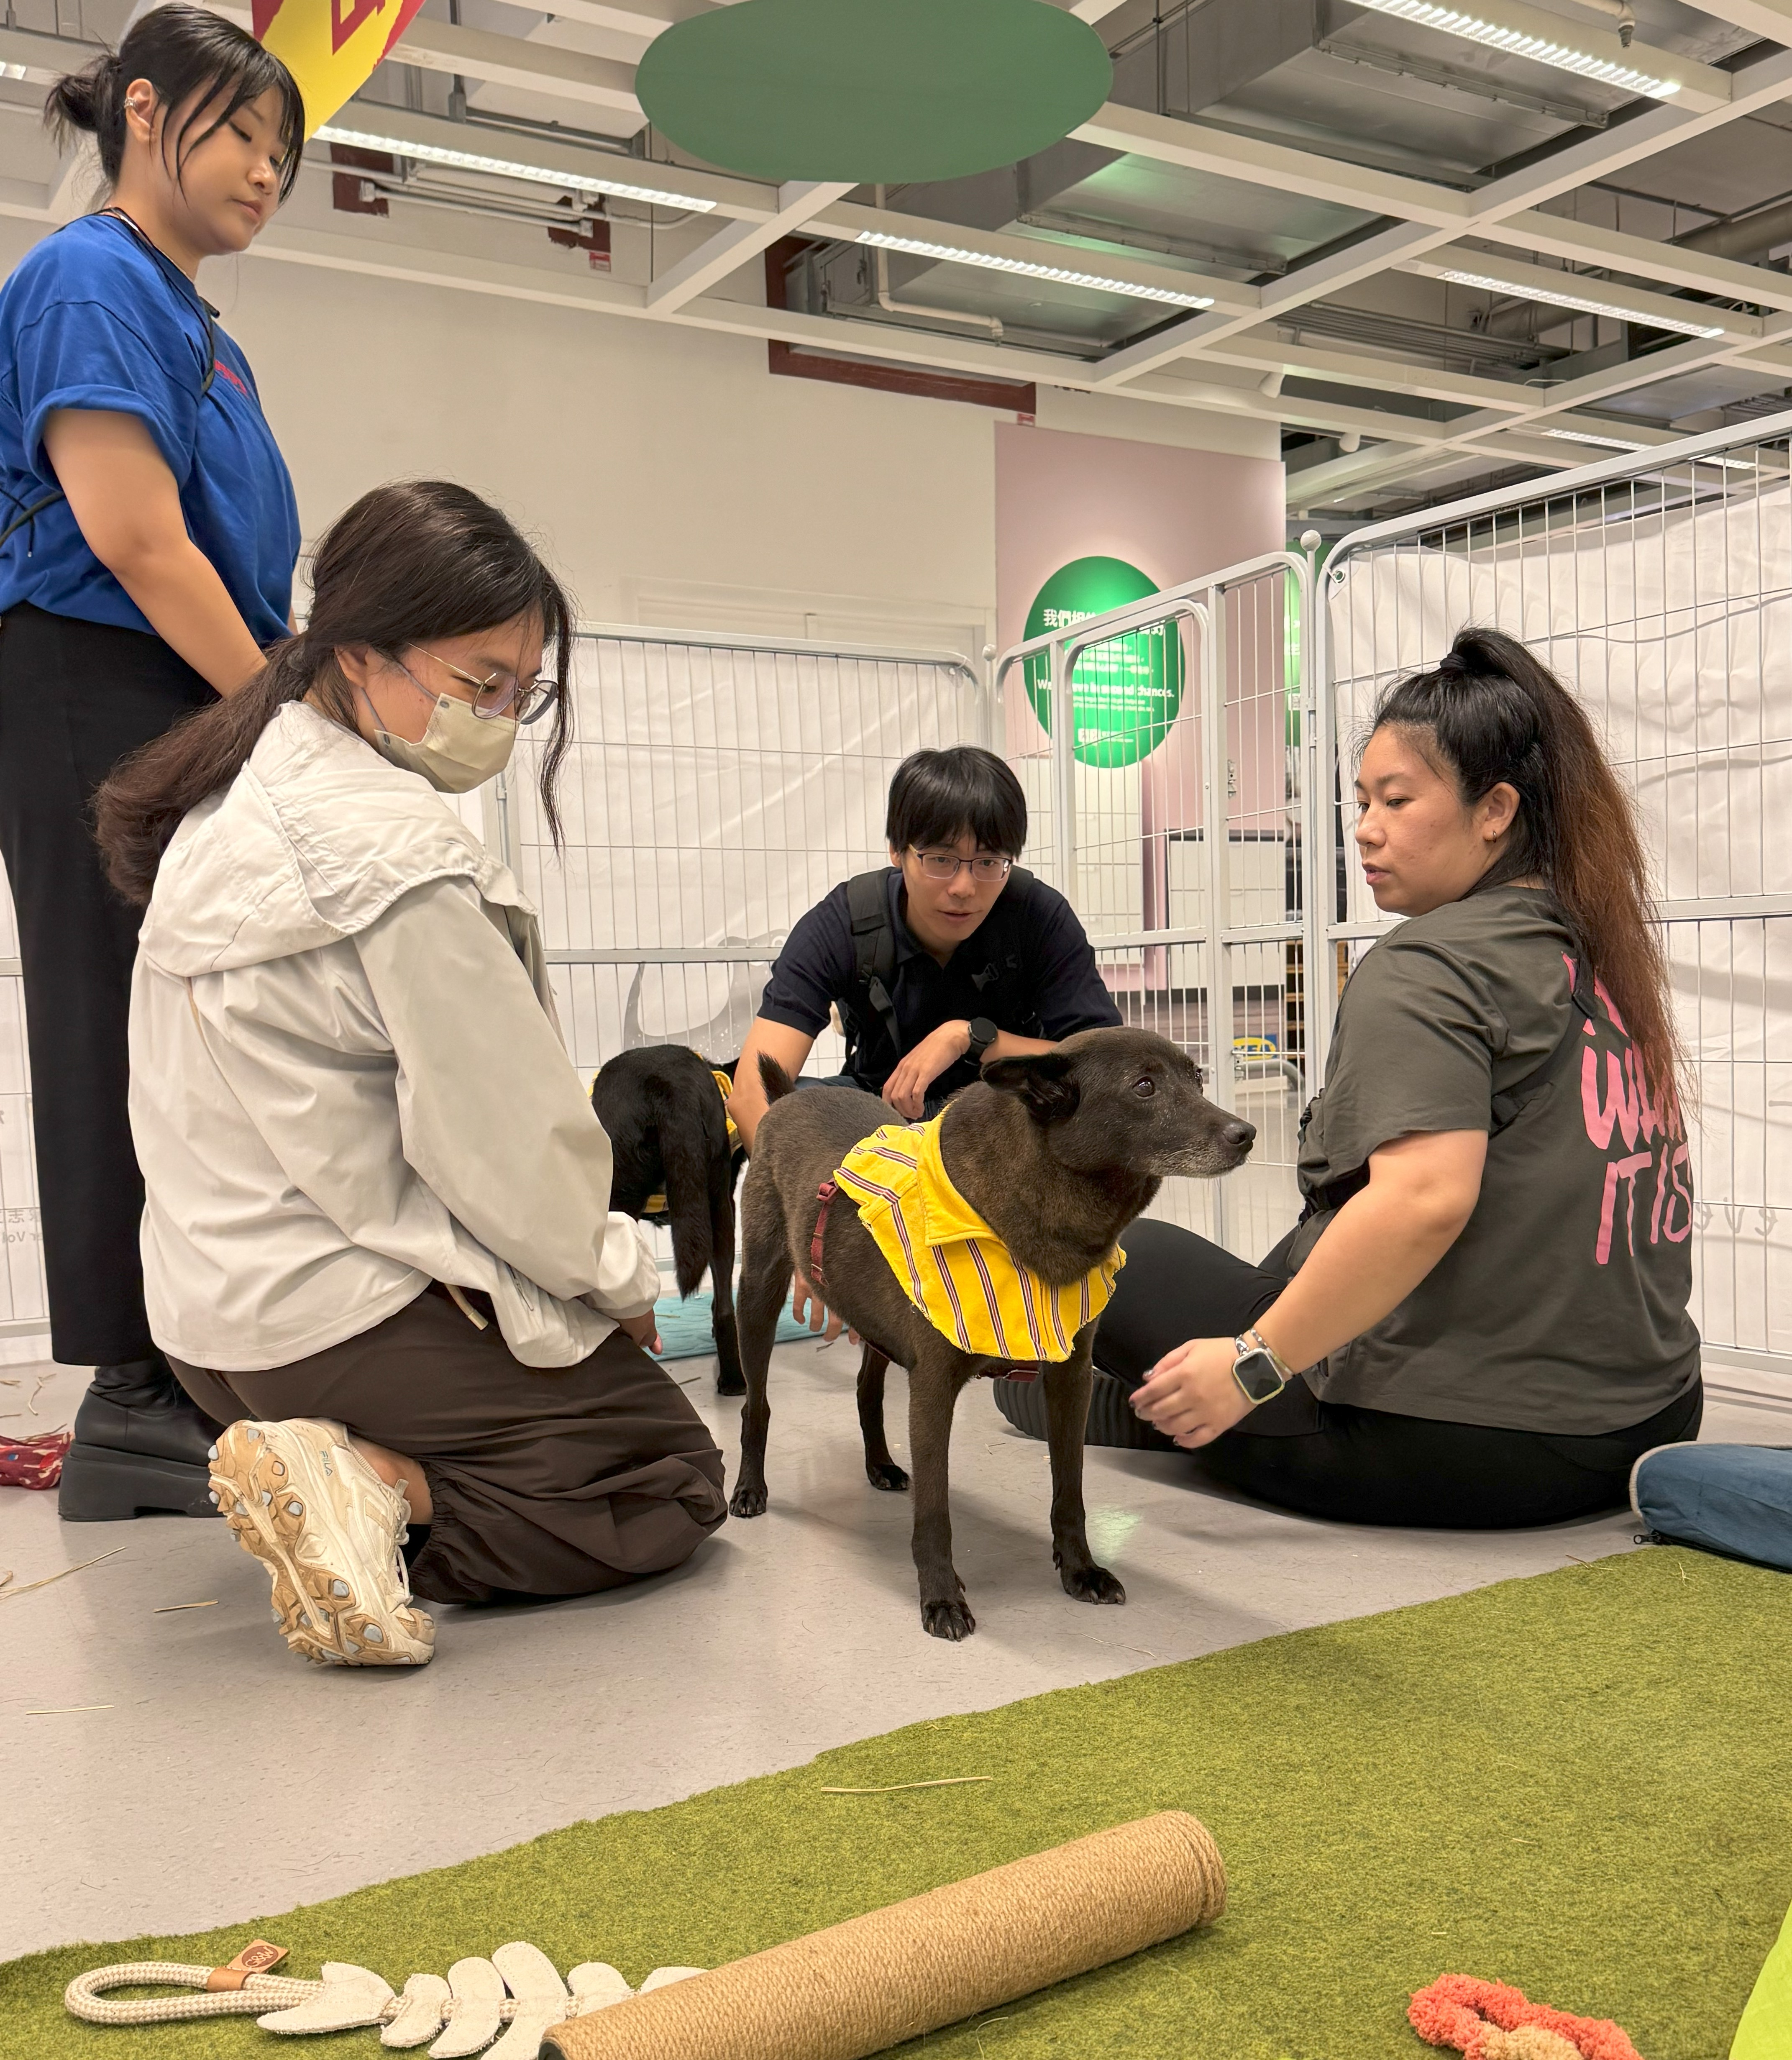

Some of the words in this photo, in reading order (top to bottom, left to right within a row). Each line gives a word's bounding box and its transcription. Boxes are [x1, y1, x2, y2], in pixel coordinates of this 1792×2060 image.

[1595, 1151, 1652, 1265] IT
[1650, 1142, 1692, 1245] IS
[319, 1450, 333, 1476] FILA
[245, 1946, 274, 1967] G&W
